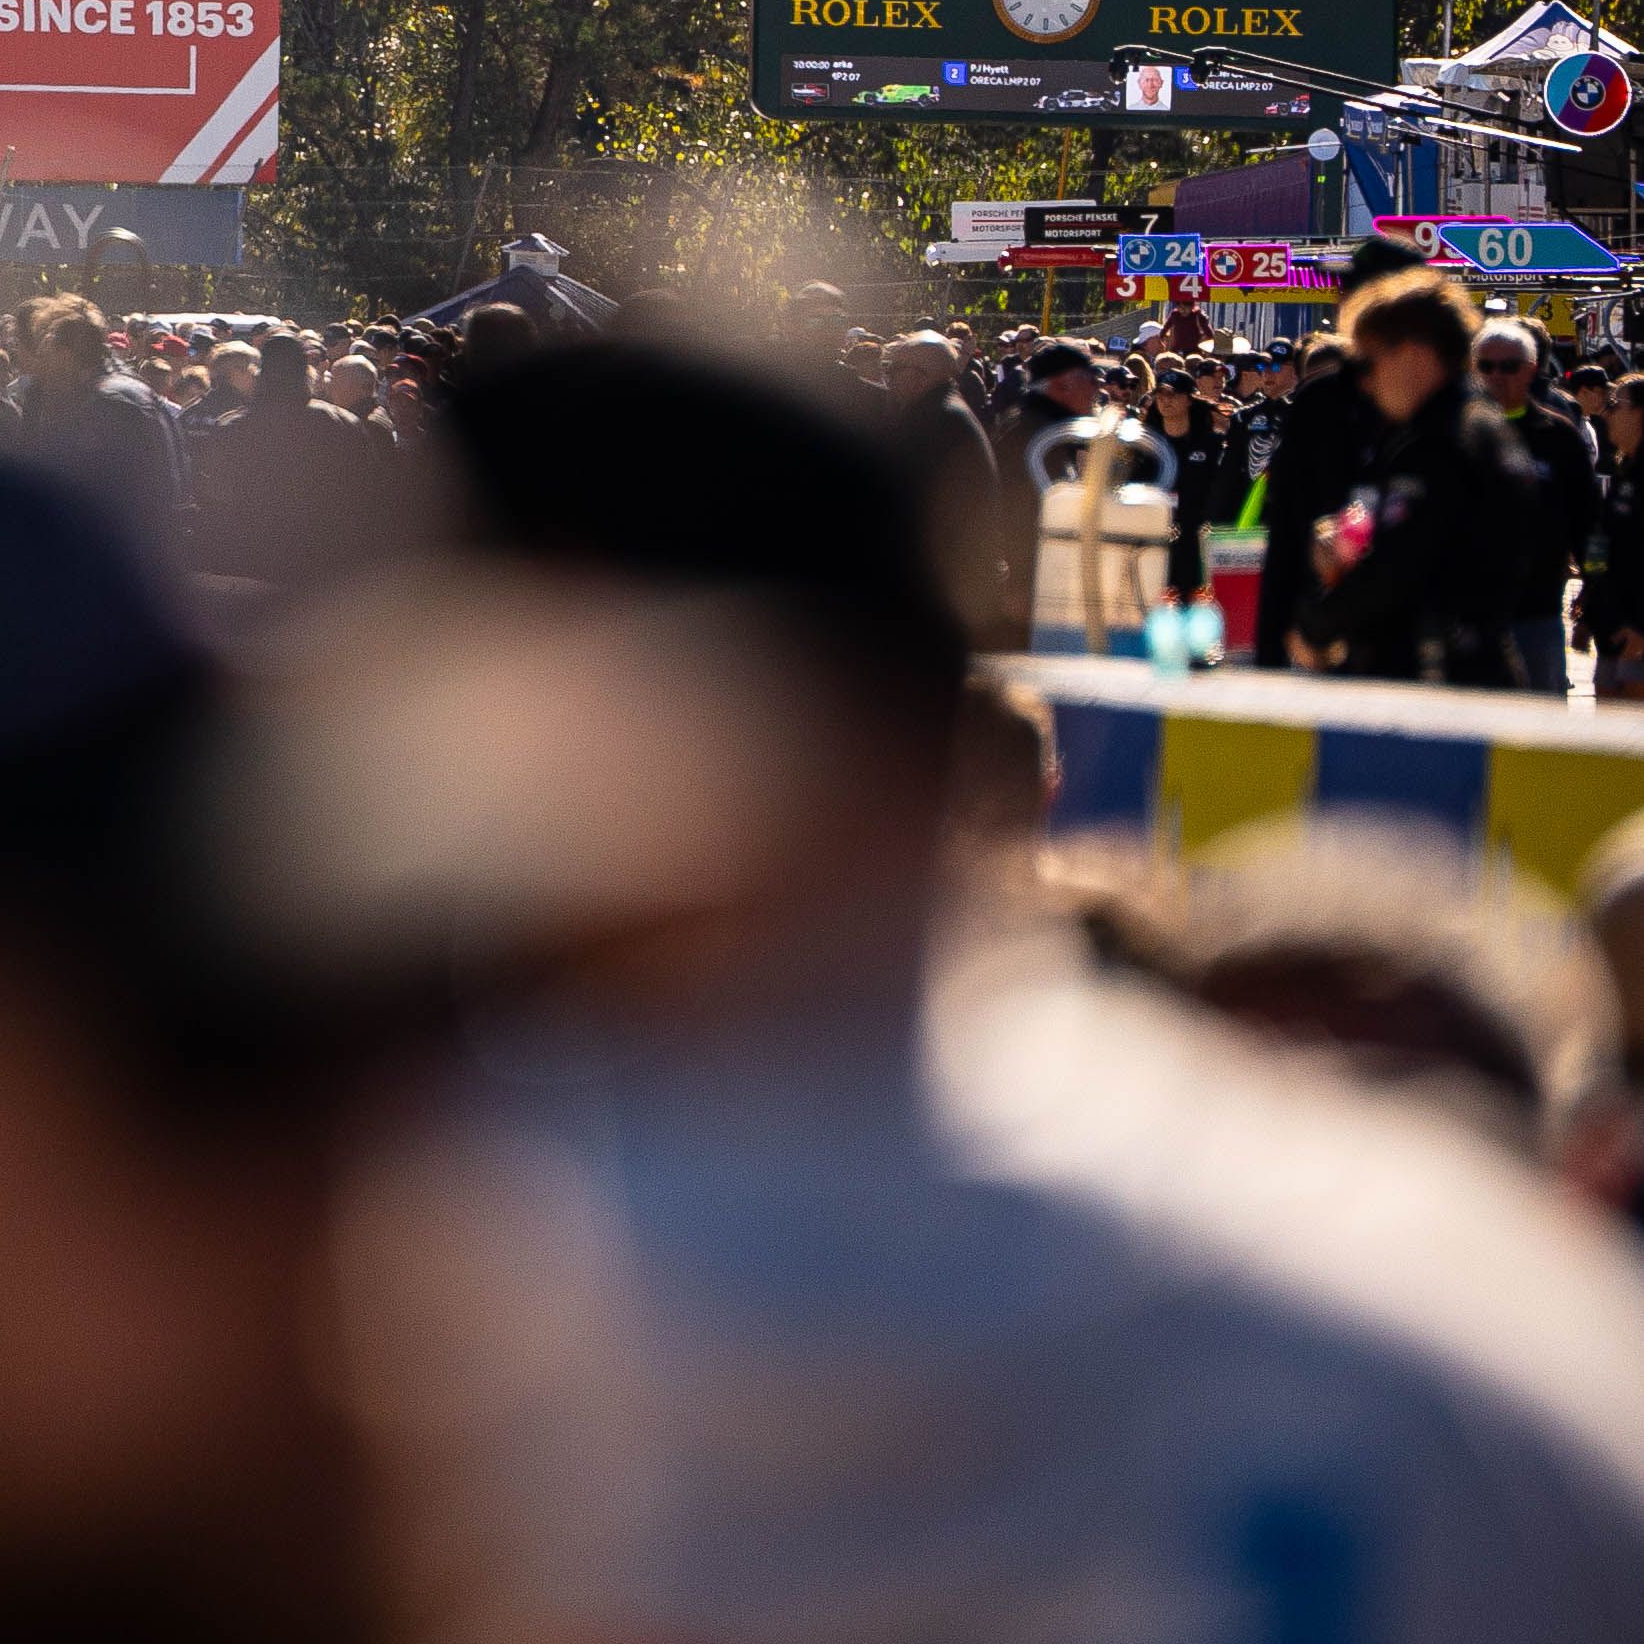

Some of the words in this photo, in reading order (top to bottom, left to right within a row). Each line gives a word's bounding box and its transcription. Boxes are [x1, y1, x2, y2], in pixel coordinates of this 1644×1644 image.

[144, 2, 254, 37] 1853
[1148, 6, 1304, 36] ROLEX
[950, 68, 959, 79] 2
[969, 75, 1002, 86] ORECA
[1003, 76, 1029, 86] LMP2
[1029, 77, 1041, 86] 07
[983, 64, 1009, 75] Hyett
[1235, 82, 1260, 91] LMP2
[1261, 83, 1274, 92] 07
[971, 209, 1009, 218] PORSCHE
[1044, 214, 1083, 223] PORSCHE
[1085, 213, 1118, 222] PENSKE
[1139, 213, 1160, 235] 7
[1044, 229, 1102, 238] MOTORSPORT
[1164, 241, 1196, 267] 24
[1478, 227, 1534, 267] 60
[1252, 252, 1287, 278] 25
[1115, 274, 1137, 298] 3
[1179, 274, 1203, 299] 4
